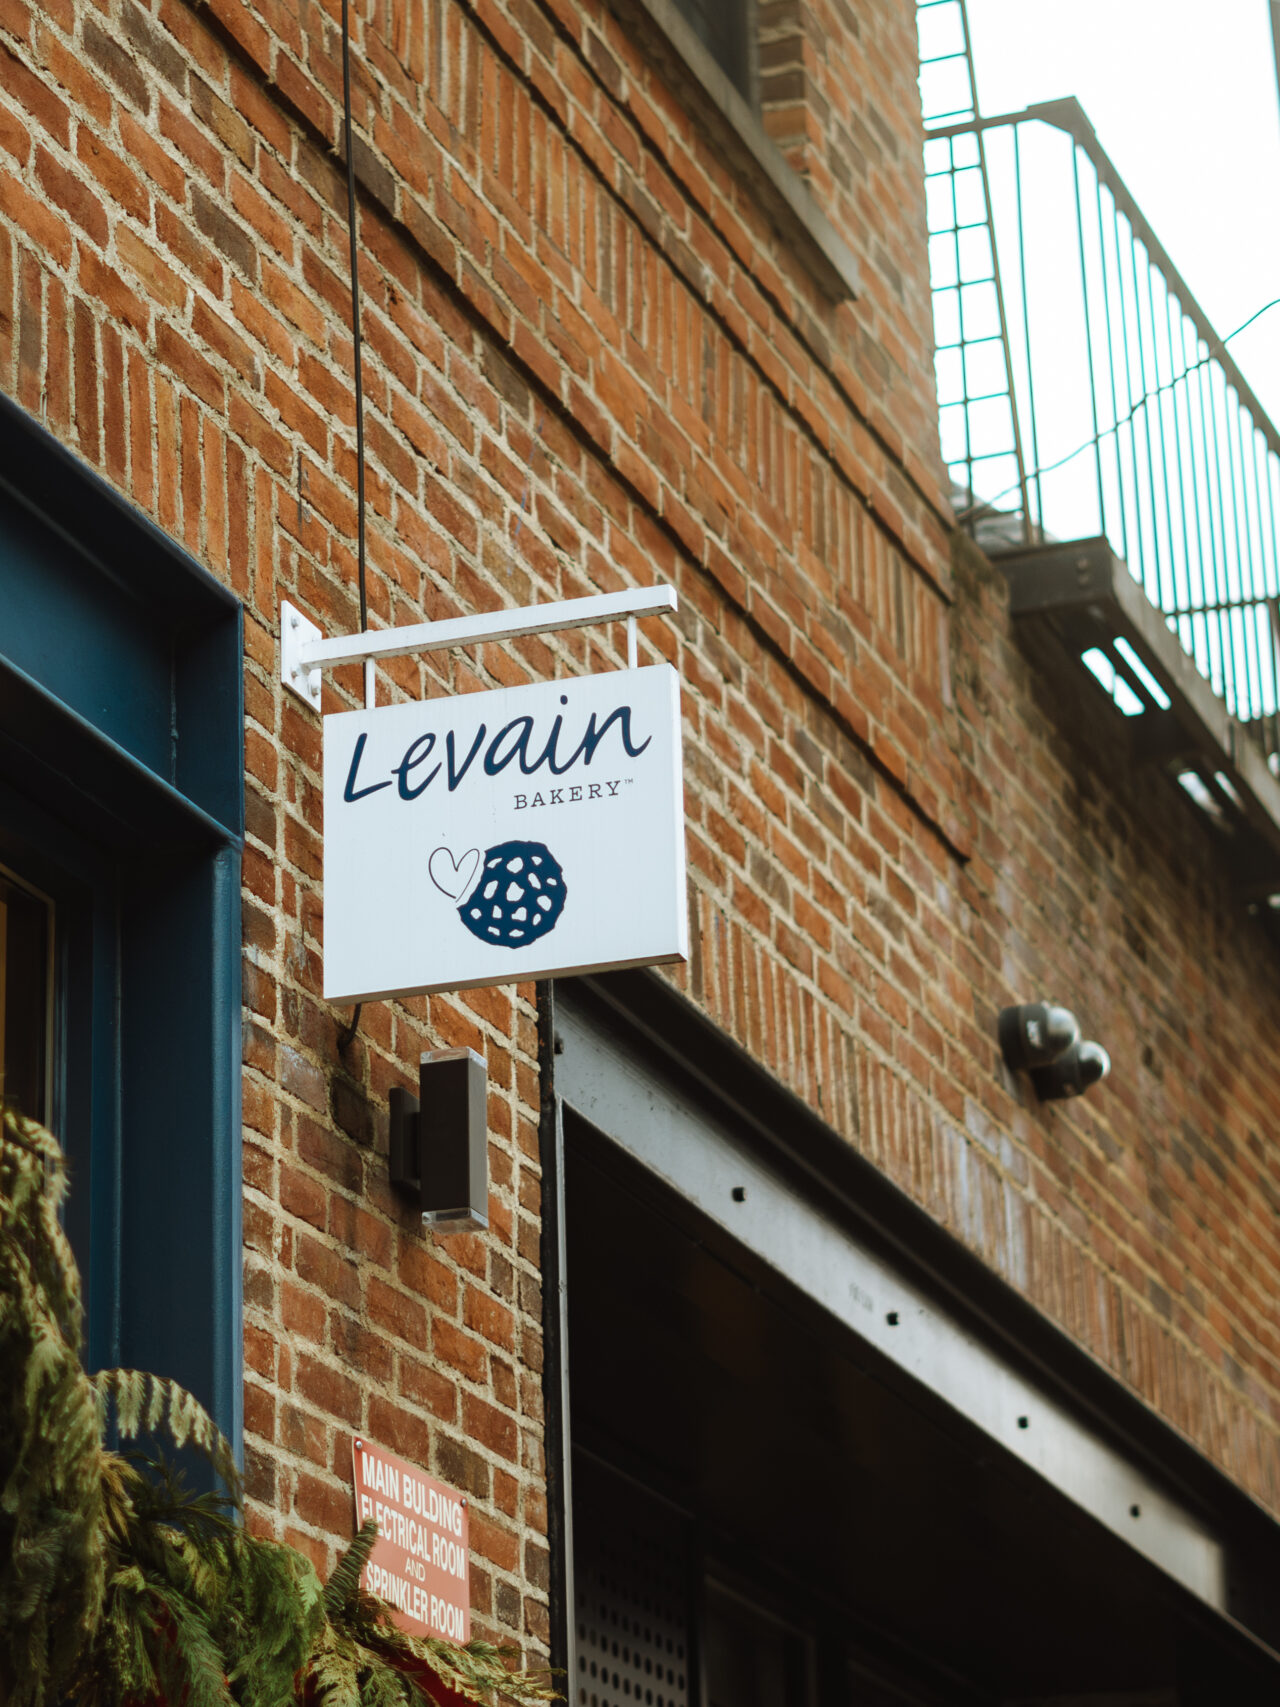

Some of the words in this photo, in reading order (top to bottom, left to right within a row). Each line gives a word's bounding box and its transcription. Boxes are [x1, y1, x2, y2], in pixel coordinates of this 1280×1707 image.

[344, 695, 652, 803] Levain
[361, 1452, 400, 1503] MAIN
[402, 1473, 463, 1537] BULDING
[405, 1556, 426, 1582] AND
[432, 1532, 466, 1581] ROOM
[365, 1559, 429, 1625] SPRINKLER
[430, 1594, 465, 1642] ROOM
